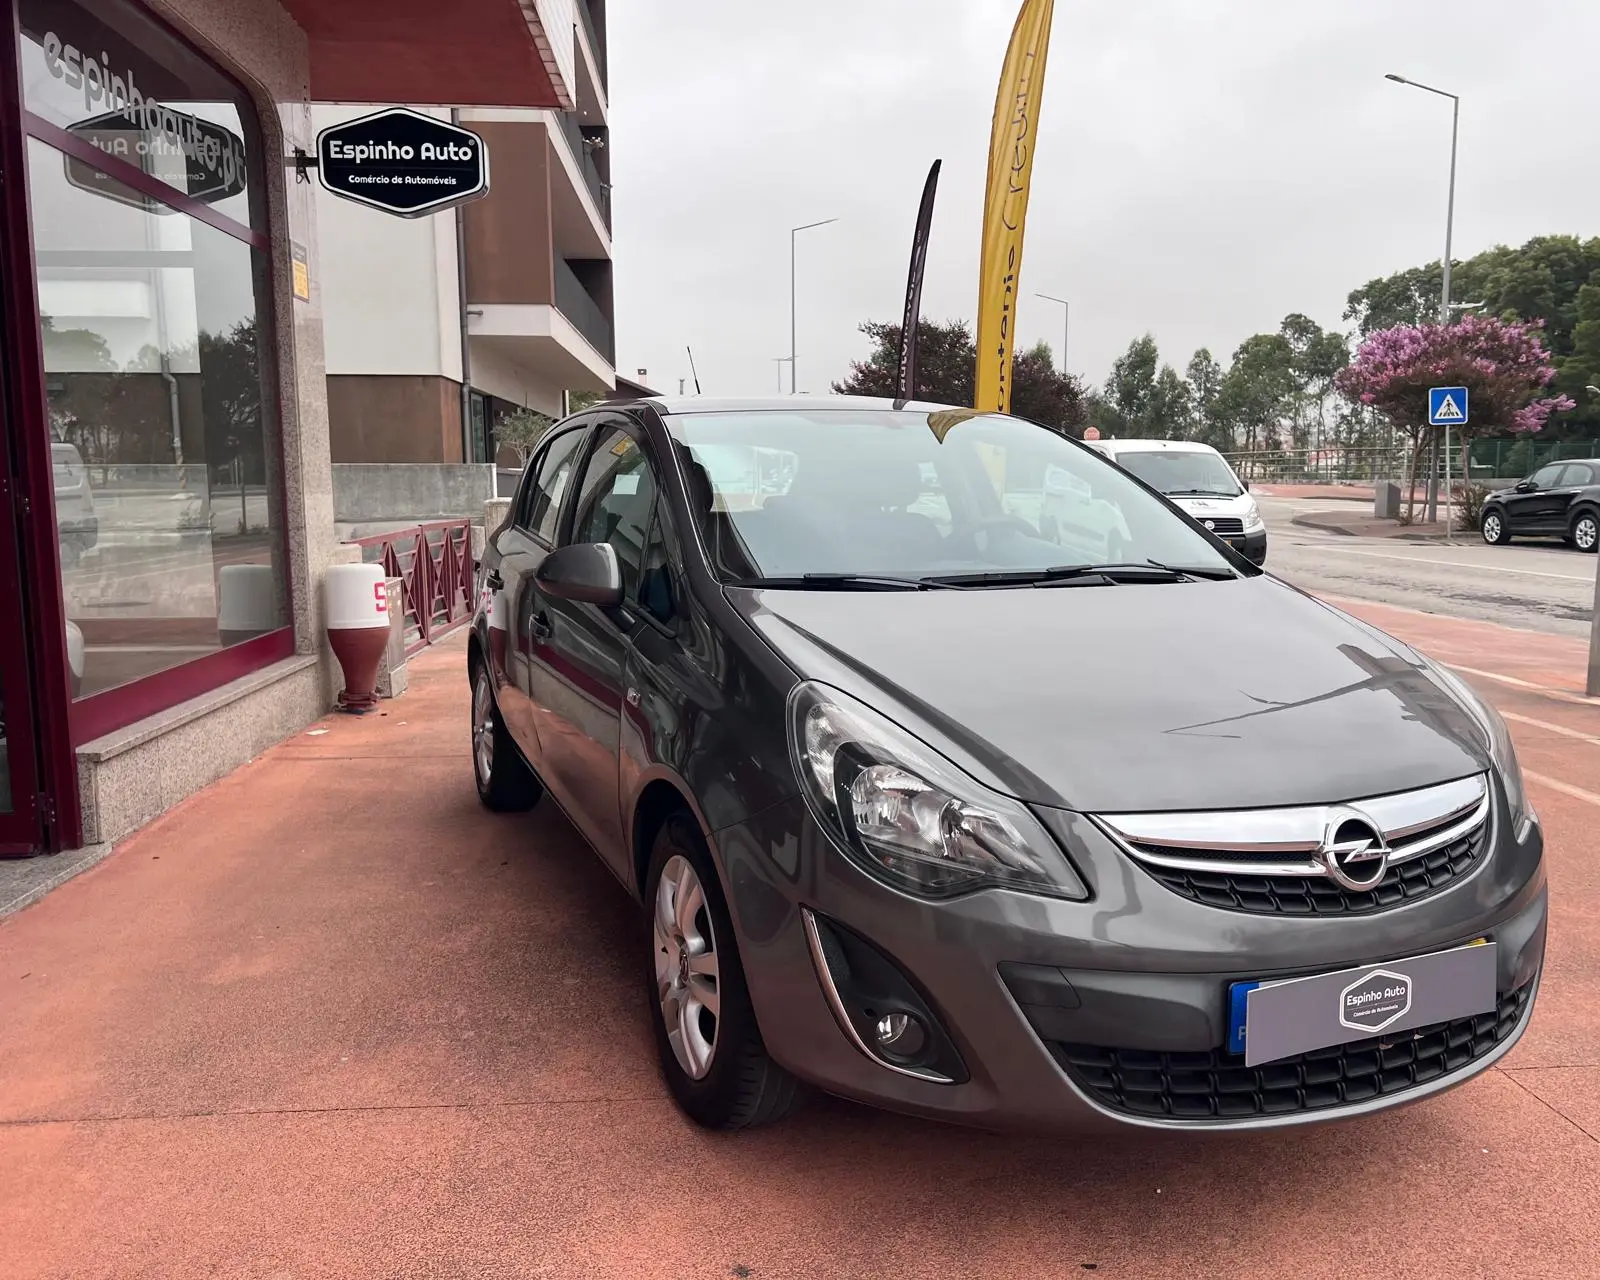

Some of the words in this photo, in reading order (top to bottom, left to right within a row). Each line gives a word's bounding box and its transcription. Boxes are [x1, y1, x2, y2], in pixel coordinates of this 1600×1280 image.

[329, 139, 415, 164] Espinho
[420, 141, 473, 161] Auto
[348, 174, 390, 184] Comércio
[391, 175, 403, 184] de
[404, 175, 457, 185] Automóveis
[1346, 990, 1383, 1006] Espinho
[1384, 985, 1406, 998] Auto
